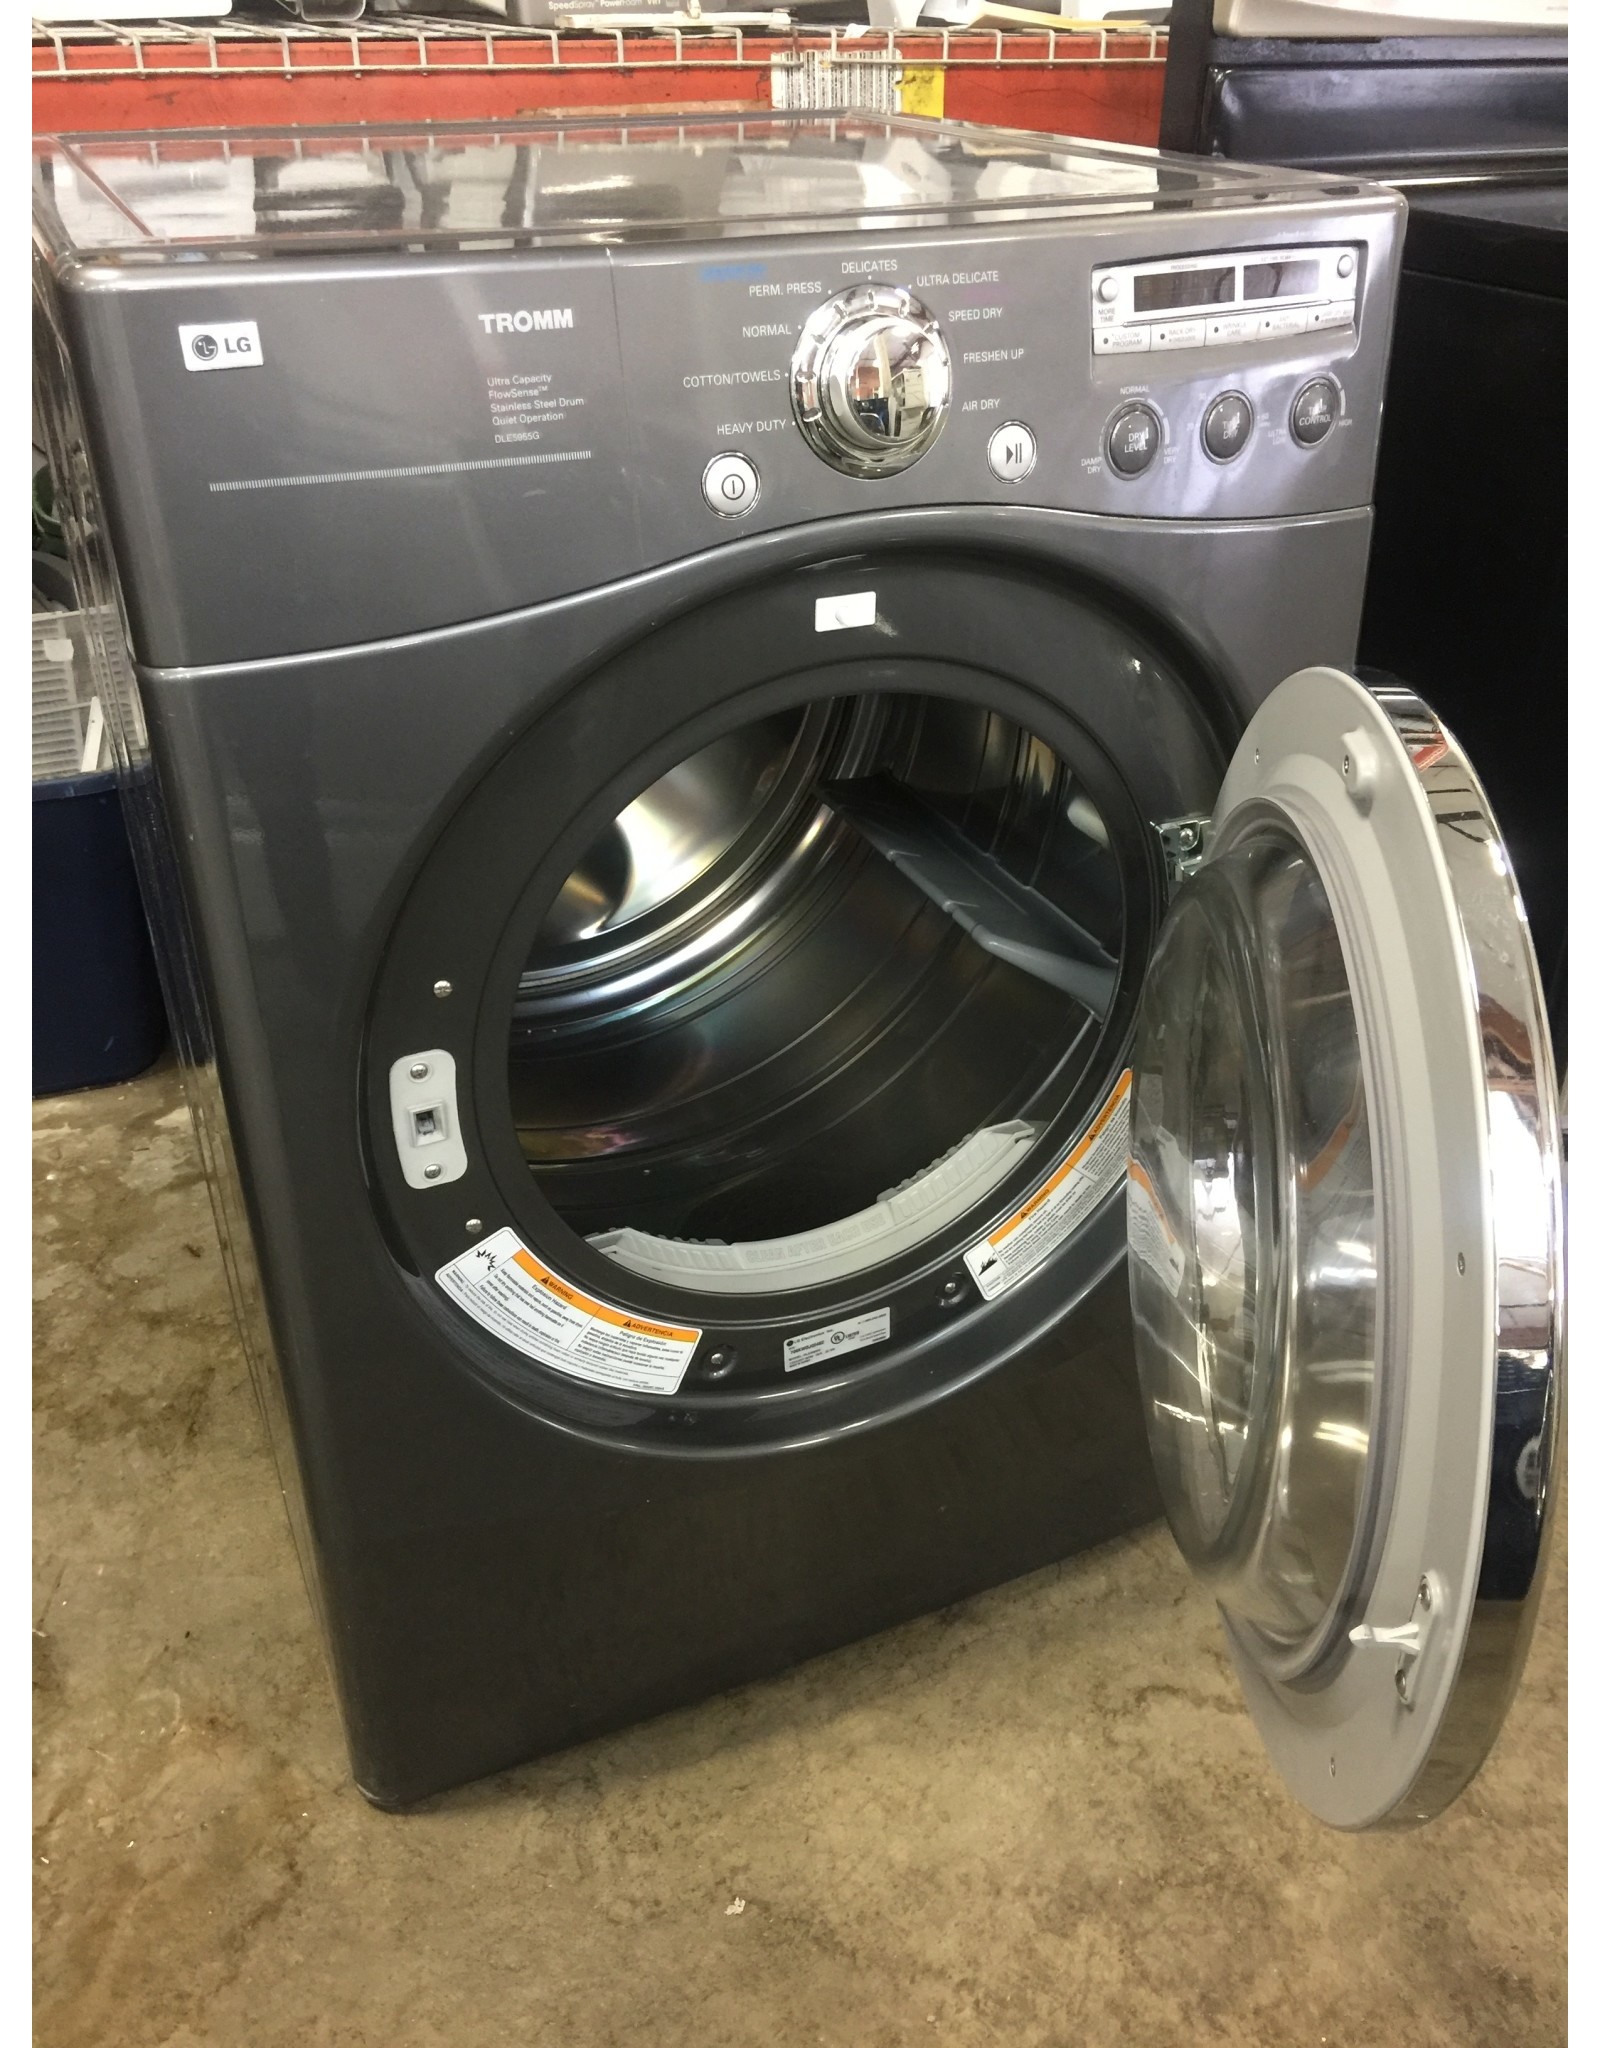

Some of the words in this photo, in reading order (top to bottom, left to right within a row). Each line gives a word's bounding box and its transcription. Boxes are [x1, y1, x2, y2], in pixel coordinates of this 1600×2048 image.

[841, 259, 898, 274] DELICATES
[916, 273, 951, 287] ULTRA
[952, 270, 1000, 285] DELICATE
[749, 283, 785, 297] PERM.
[786, 281, 822, 295] PRESS
[478, 308, 574, 334] TROMM
[948, 309, 981, 322] SPEED
[982, 307, 1003, 320] DRY
[742, 323, 792, 338] NORMAL
[224, 336, 252, 354] LG
[1112, 339, 1142, 347] PROGRAM
[963, 349, 1008, 364] FRESHEN
[1010, 348, 1025, 361] UP
[487, 377, 511, 387] Ultra
[512, 374, 553, 386] Capacity
[683, 369, 781, 388] COTTON/TOWELS
[1120, 385, 1150, 395] NORMAL
[490, 401, 533, 413] Stainless
[533, 399, 557, 409] Steel
[559, 397, 585, 408] Drum
[962, 400, 980, 412] AIR
[980, 398, 1001, 411] DRY
[492, 415, 517, 426] Quiet
[519, 412, 564, 424] Operation
[1298, 414, 1331, 426] CONTROL
[716, 421, 753, 436] HEAVY
[756, 418, 787, 433] DUTY
[1128, 431, 1145, 442] DRY
[1124, 442, 1147, 453] LEVEL
[1081, 457, 1102, 466] DAMP
[1163, 456, 1176, 464] DRY
[1087, 466, 1101, 474] DRY
[549, 1281, 574, 1300] WARNING
[631, 1322, 673, 1337] ADVERTENCIA
